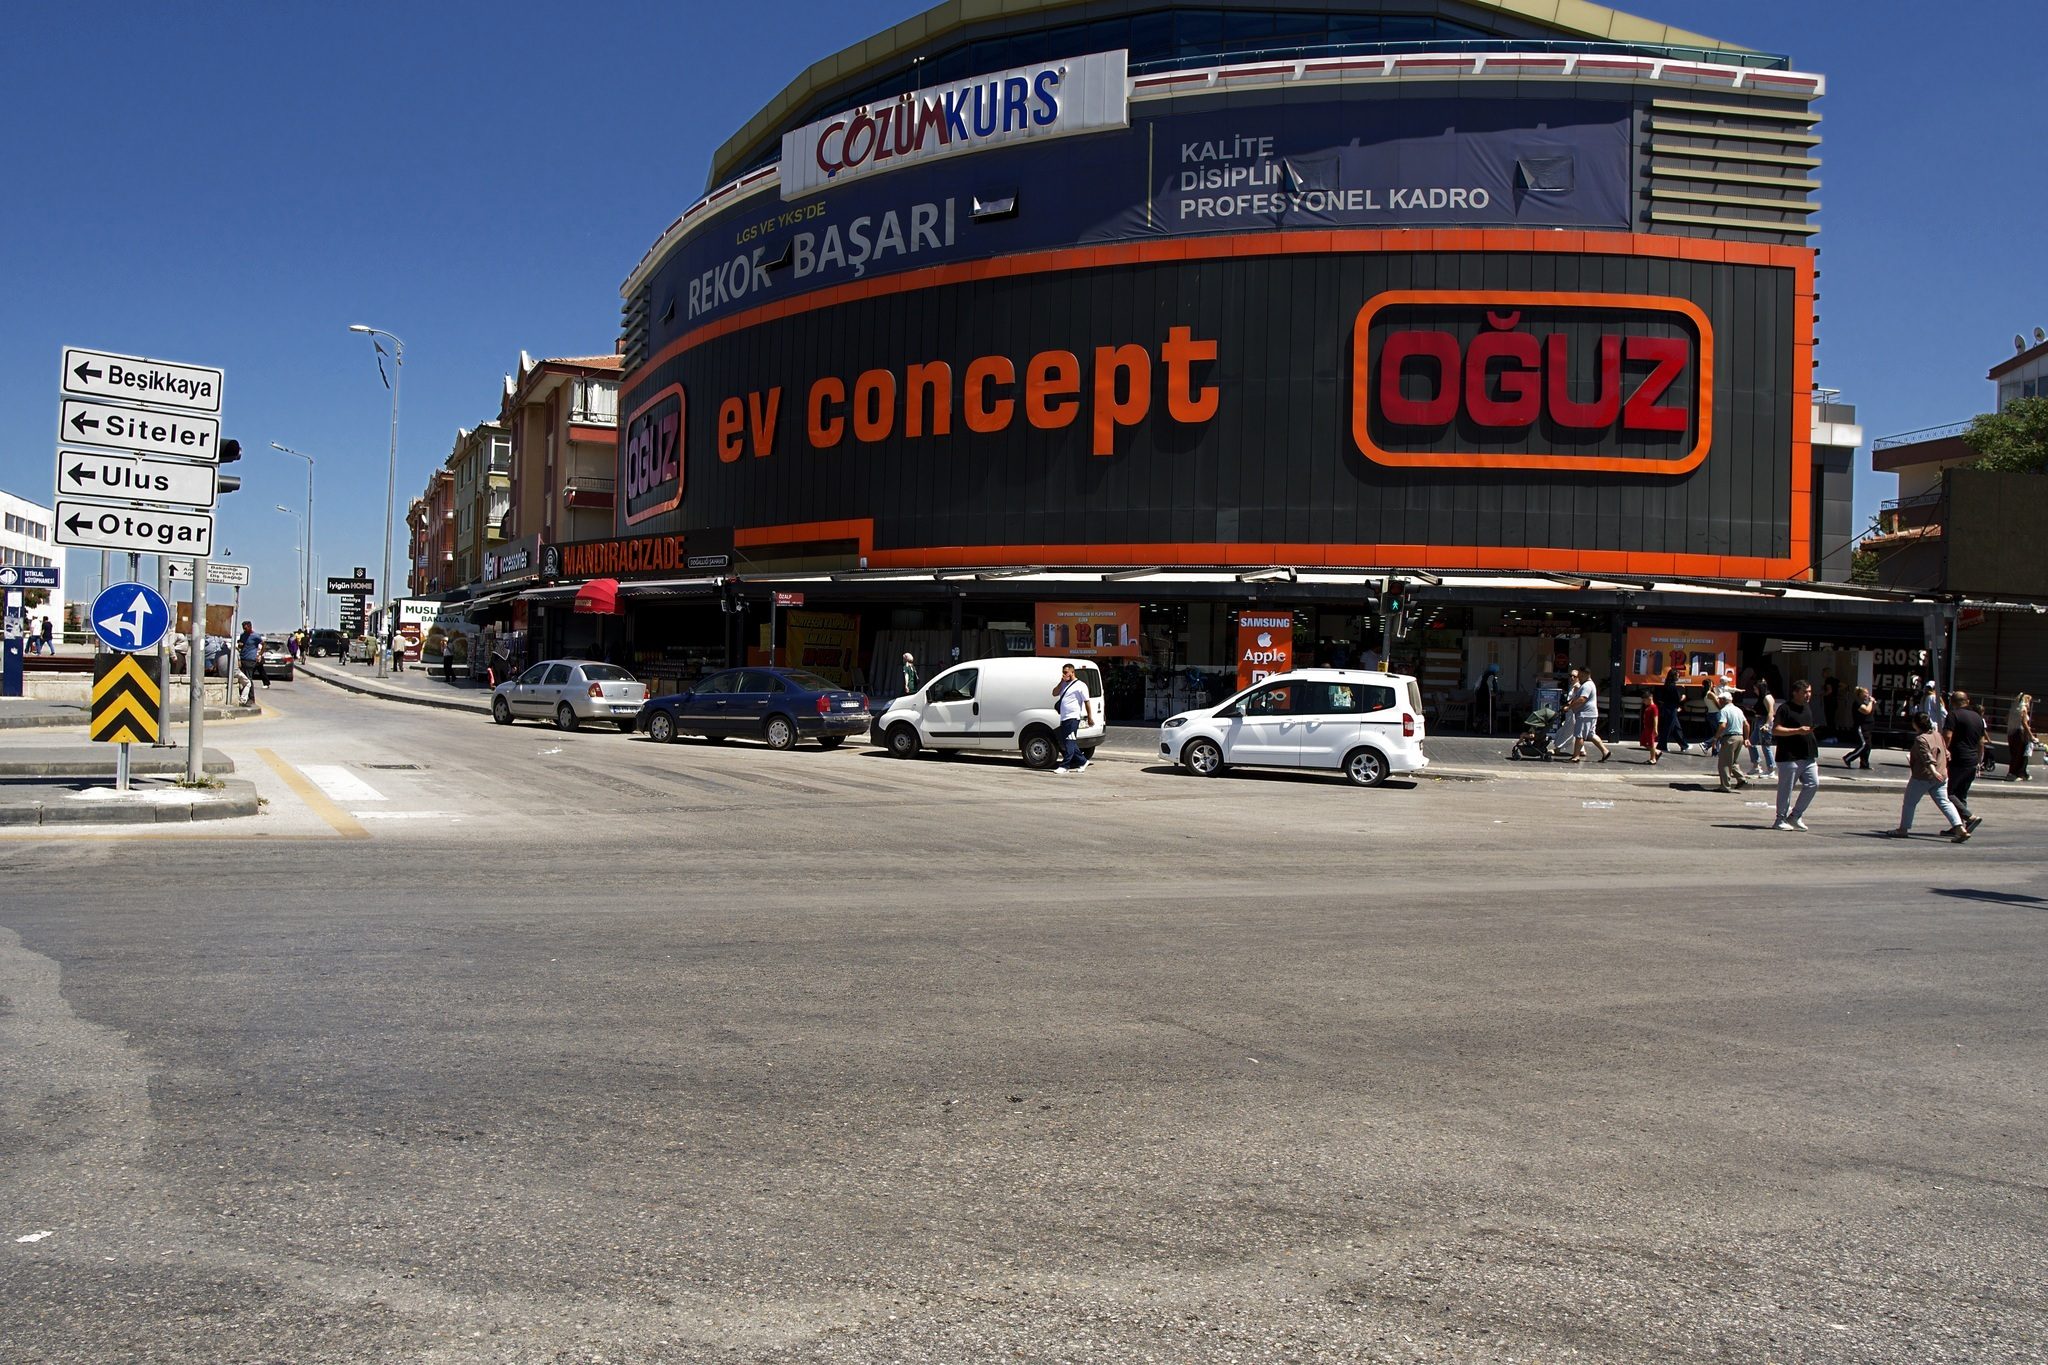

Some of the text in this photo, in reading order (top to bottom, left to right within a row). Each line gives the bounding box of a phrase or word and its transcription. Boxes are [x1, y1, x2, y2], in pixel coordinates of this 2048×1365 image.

[1181, 134, 1274, 163] KALİTE
[1180, 187, 1490, 220] PROFESYONEL KADRO
[736, 201, 826, 245] LGS VE YKS'DE
[793, 197, 955, 279] BAŞARI
[108, 364, 212, 400] Beşikkaya
[1380, 310, 1689, 432] OĞUZ
[718, 326, 1220, 464] ev concept
[105, 415, 210, 447] Siteler
[627, 411, 679, 500] OĞUZ
[102, 465, 169, 491] Ulus
[98, 513, 207, 545] Otogar
[563, 535, 685, 576] MANDIRACIZADE
[405, 605, 445, 615] MUSLU
[1240, 618, 1290, 628] SAMSUNG
[1243, 648, 1286, 665] Apple
[1873, 648, 1929, 667] GROSS
